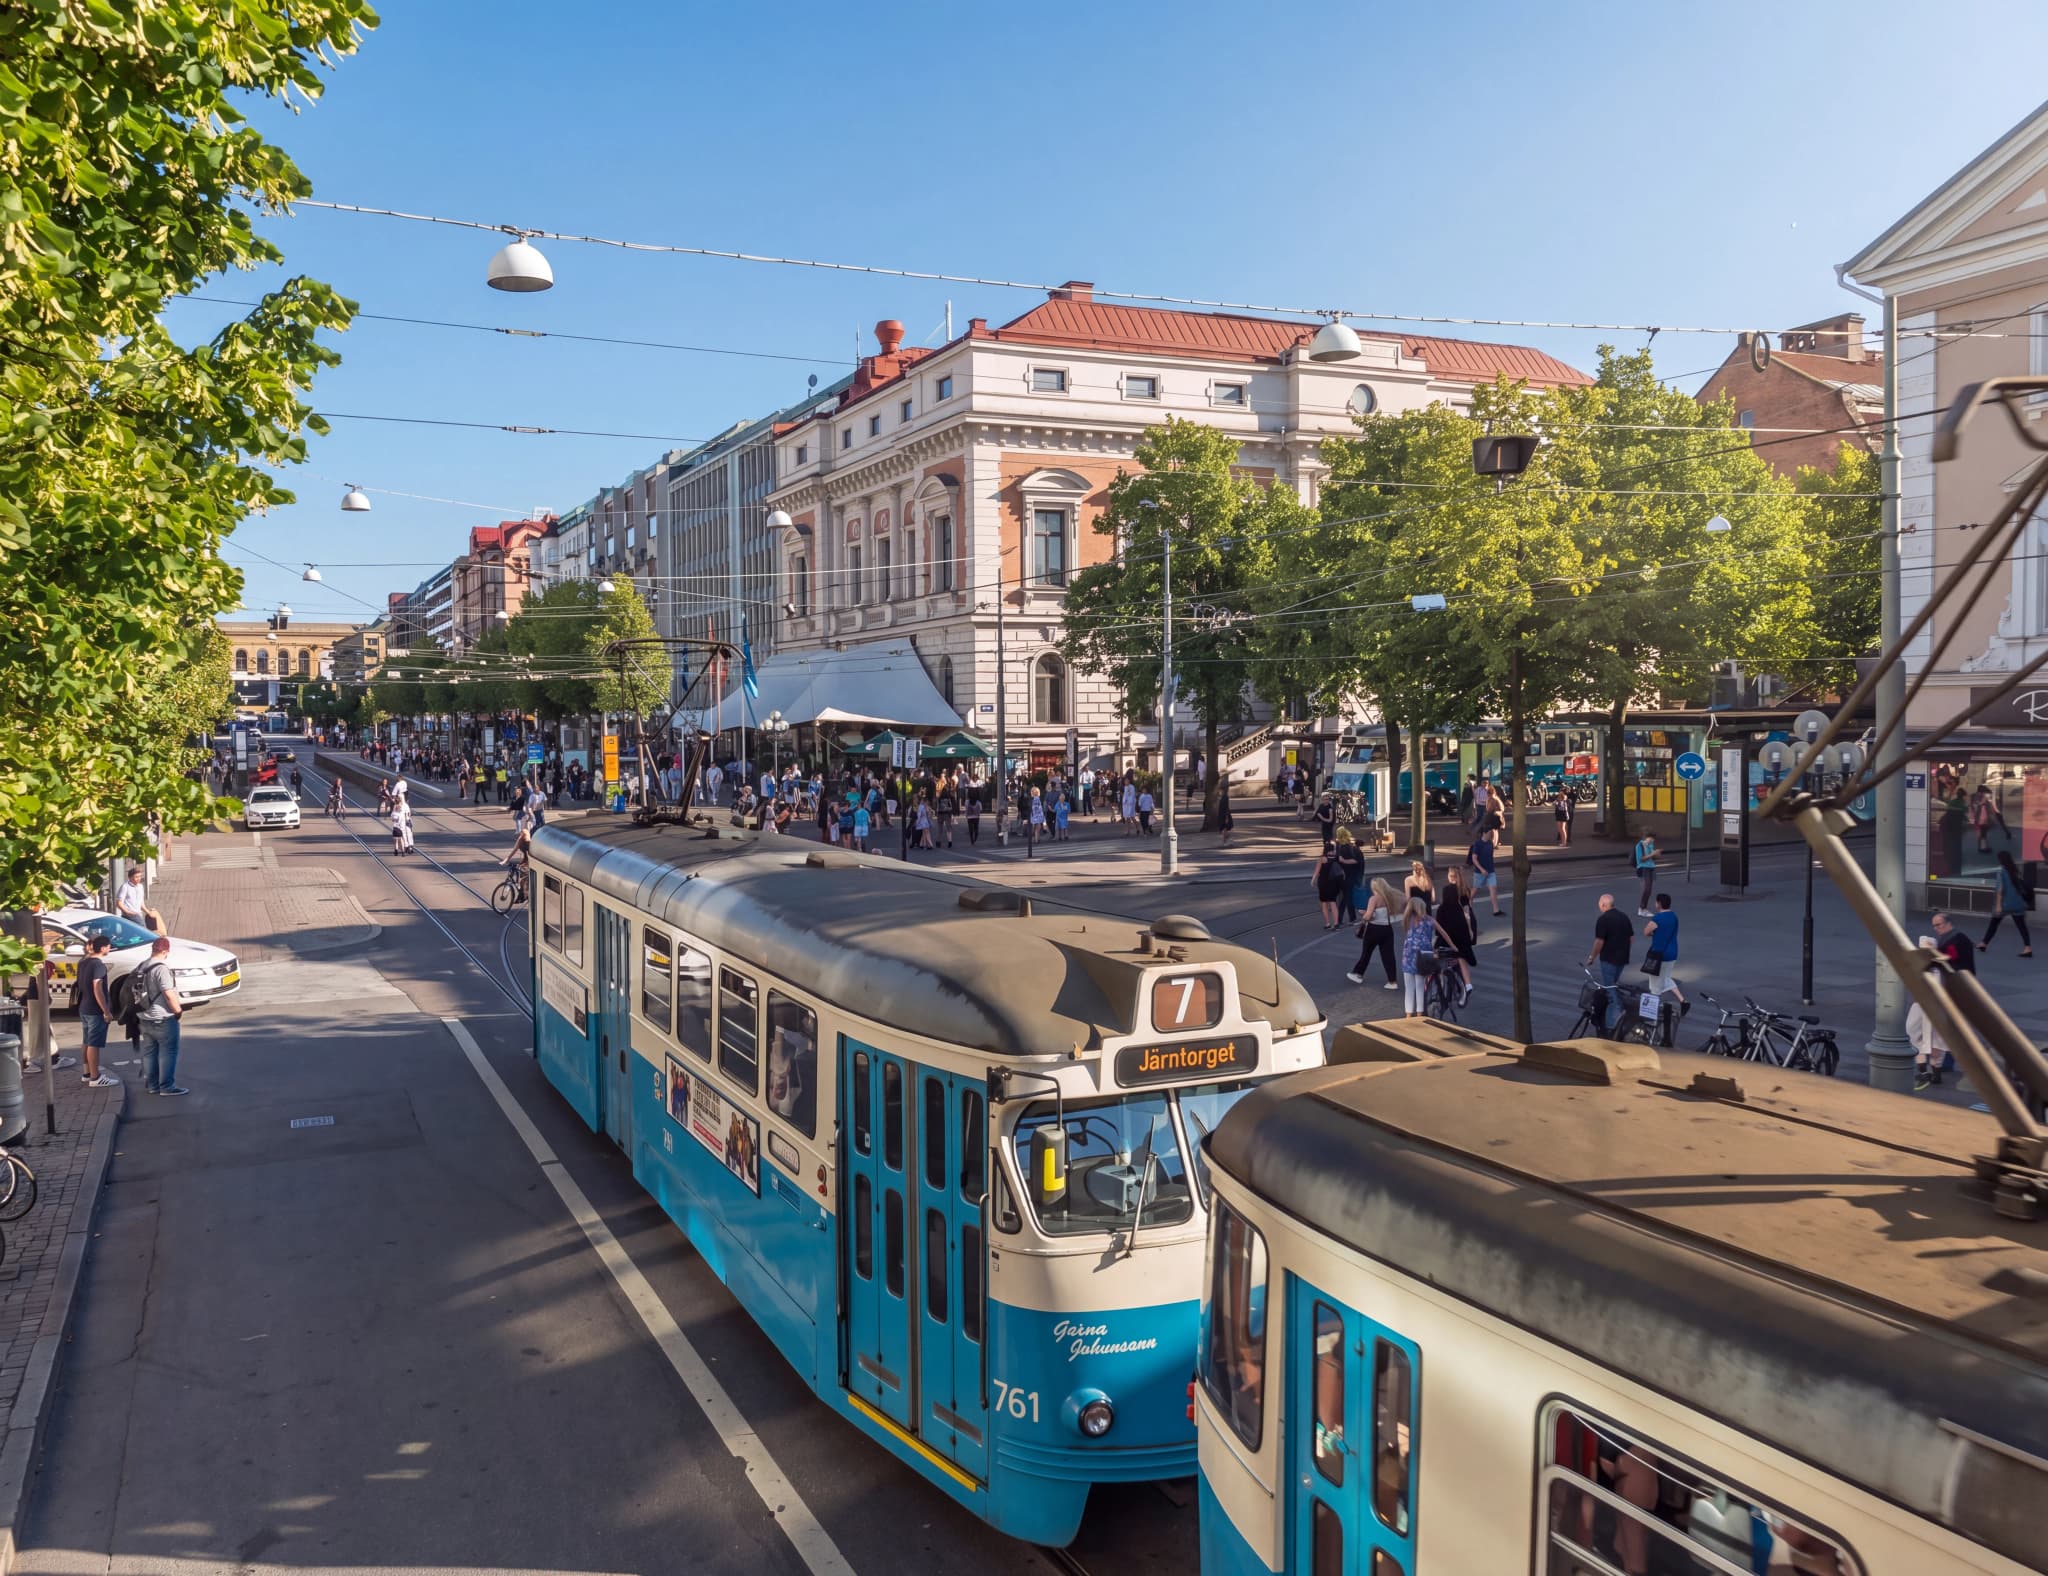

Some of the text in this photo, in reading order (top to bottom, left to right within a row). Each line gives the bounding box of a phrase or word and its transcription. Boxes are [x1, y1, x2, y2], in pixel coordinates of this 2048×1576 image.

[1171, 976, 1195, 1024] 7
[1138, 1042, 1236, 1072] Järntorget
[993, 1378, 1039, 1424] 761
